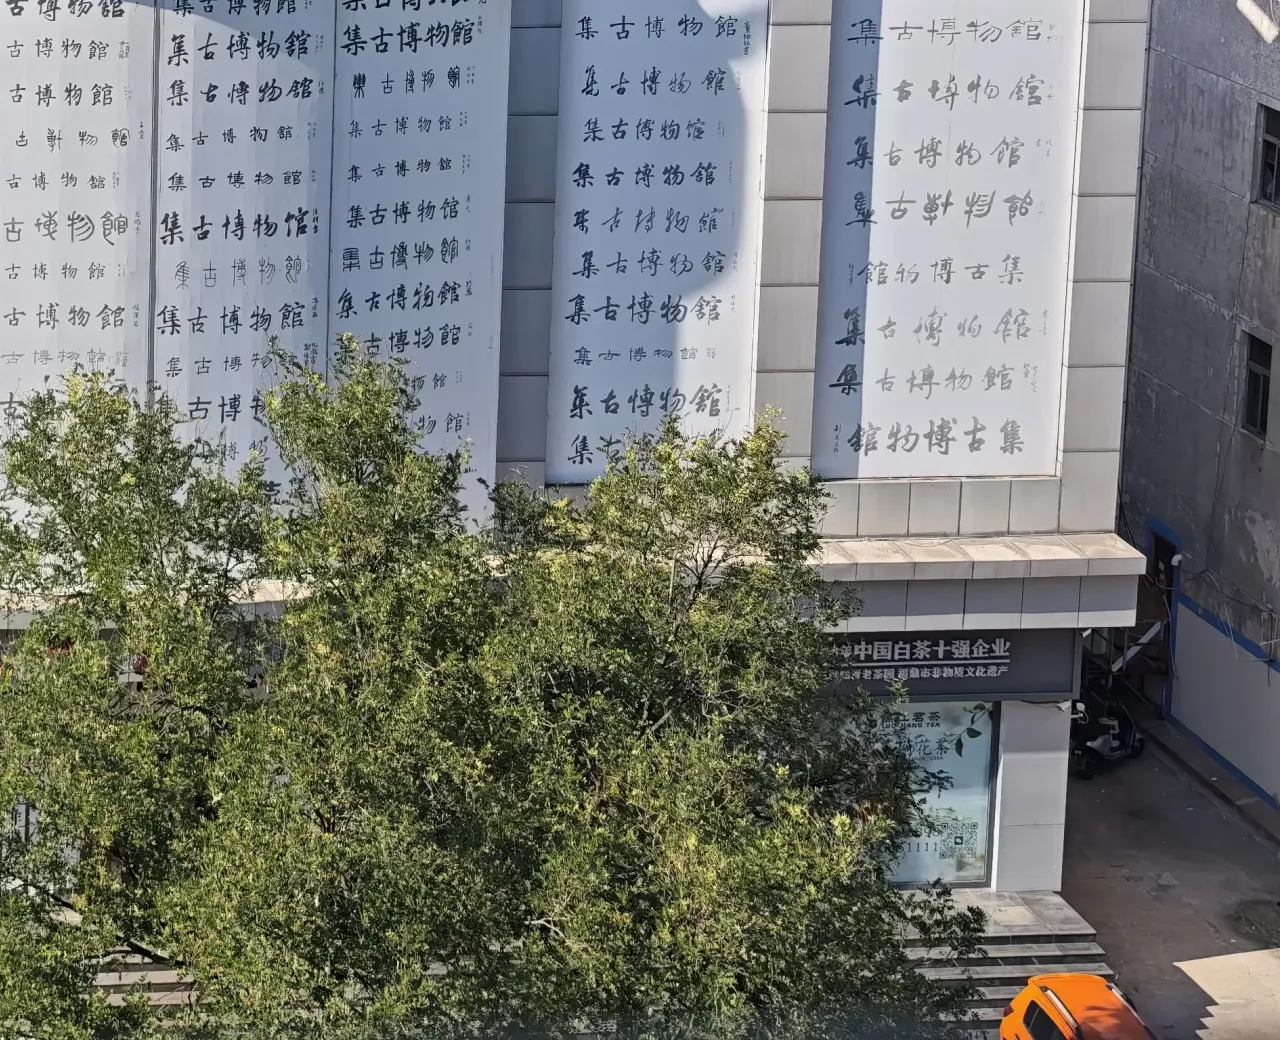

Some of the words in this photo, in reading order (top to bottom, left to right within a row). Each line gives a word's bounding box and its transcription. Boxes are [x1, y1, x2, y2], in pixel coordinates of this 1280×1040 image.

[853, 638, 1010, 660] 中国白茶十强企业
